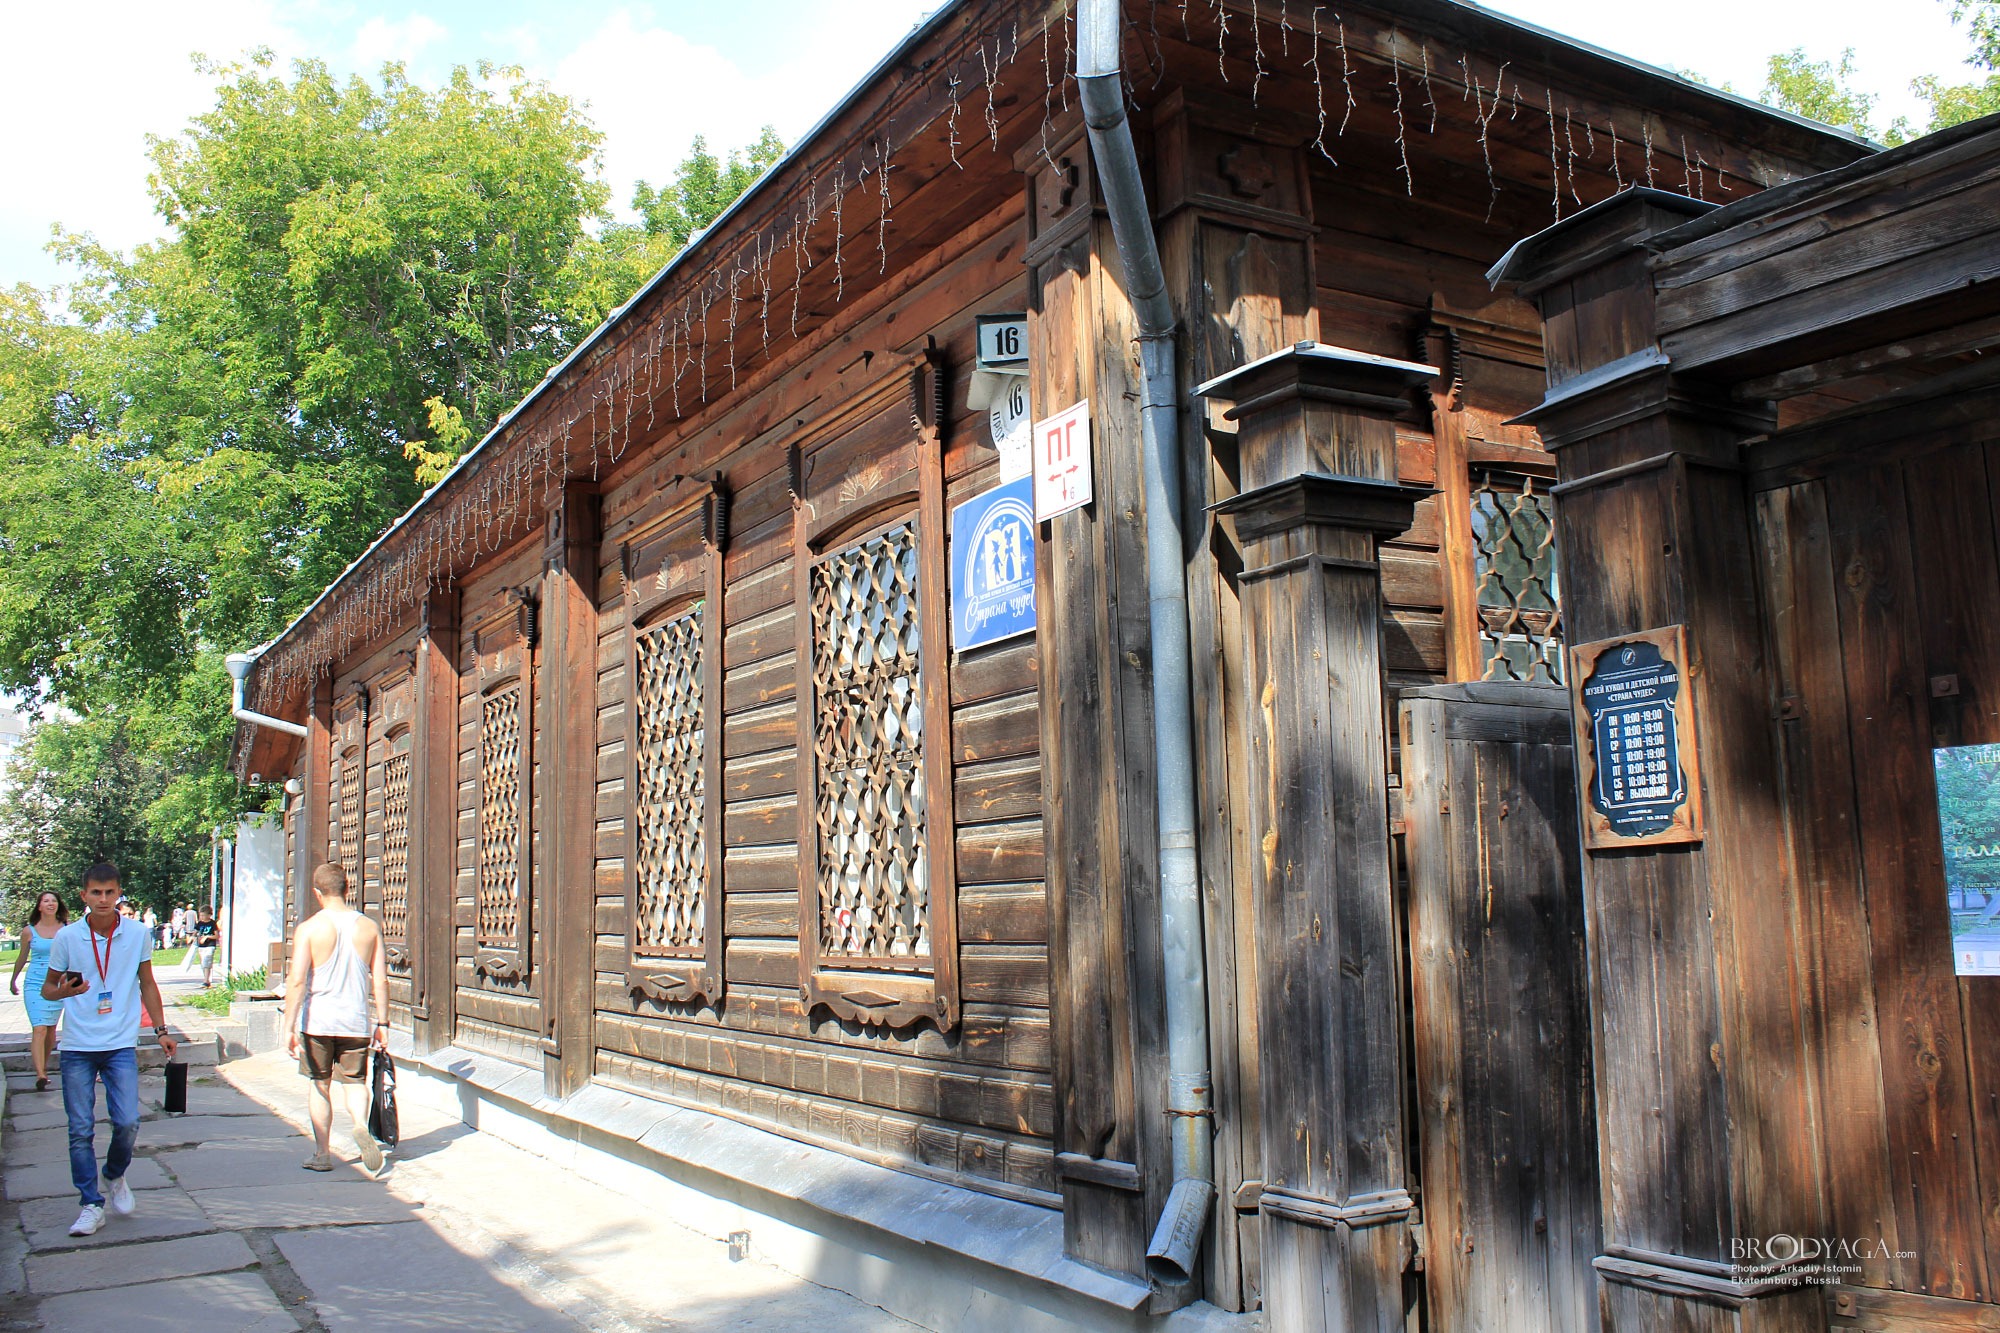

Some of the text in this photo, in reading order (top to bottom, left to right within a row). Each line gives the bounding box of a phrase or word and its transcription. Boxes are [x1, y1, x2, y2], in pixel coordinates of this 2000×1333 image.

[995, 327, 1019, 356] 16
[1009, 384, 1023, 420] 16
[1047, 419, 1077, 465] ПГ
[1070, 487, 1075, 500] 6
[965, 596, 1007, 632] Страна
[1585, 686, 1605, 696] МУЗЕЙ
[1605, 683, 1625, 693] КУКОЛ
[1625, 682, 1630, 690] И
[1631, 675, 1659, 690] ДЕТСКОЙ
[1608, 715, 1618, 726] ПН
[1609, 727, 1618, 739] ВТ
[1610, 740, 1619, 751] СР
[1611, 753, 1620, 763] ЧТ
[1612, 765, 1621, 776] ПТ
[1613, 777, 1623, 789] СБ
[1614, 784, 1668, 801] ВС ВЫХОДНОЙ
[1952, 823, 1964, 835] 12
